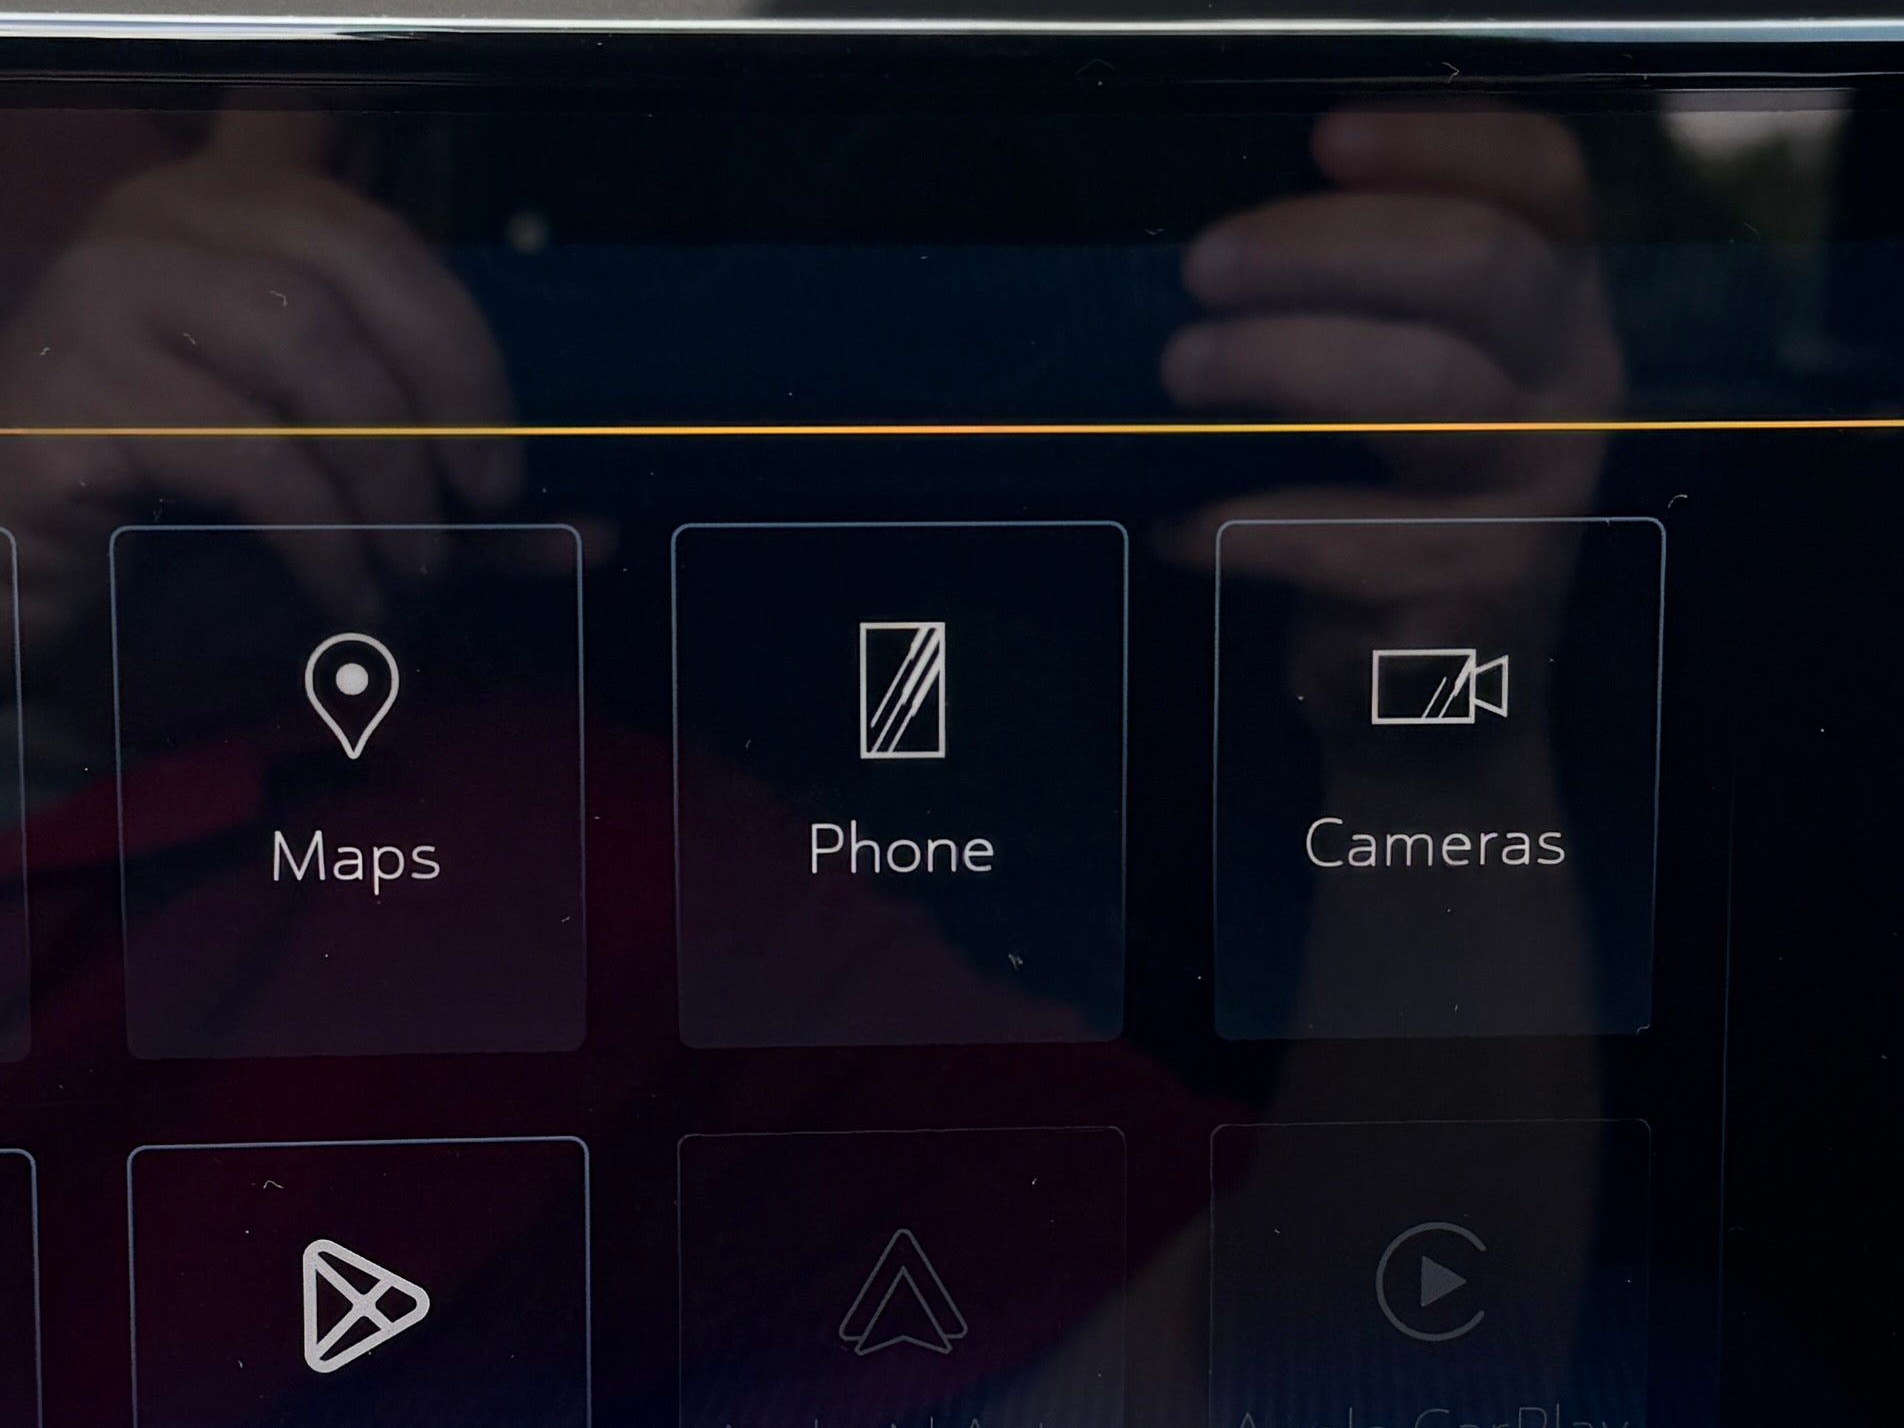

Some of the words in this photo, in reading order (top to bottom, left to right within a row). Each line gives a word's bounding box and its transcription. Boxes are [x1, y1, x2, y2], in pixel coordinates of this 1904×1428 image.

[272, 829, 441, 897] Maps
[811, 819, 995, 875] Phone
[1304, 816, 1566, 869] Cameras
